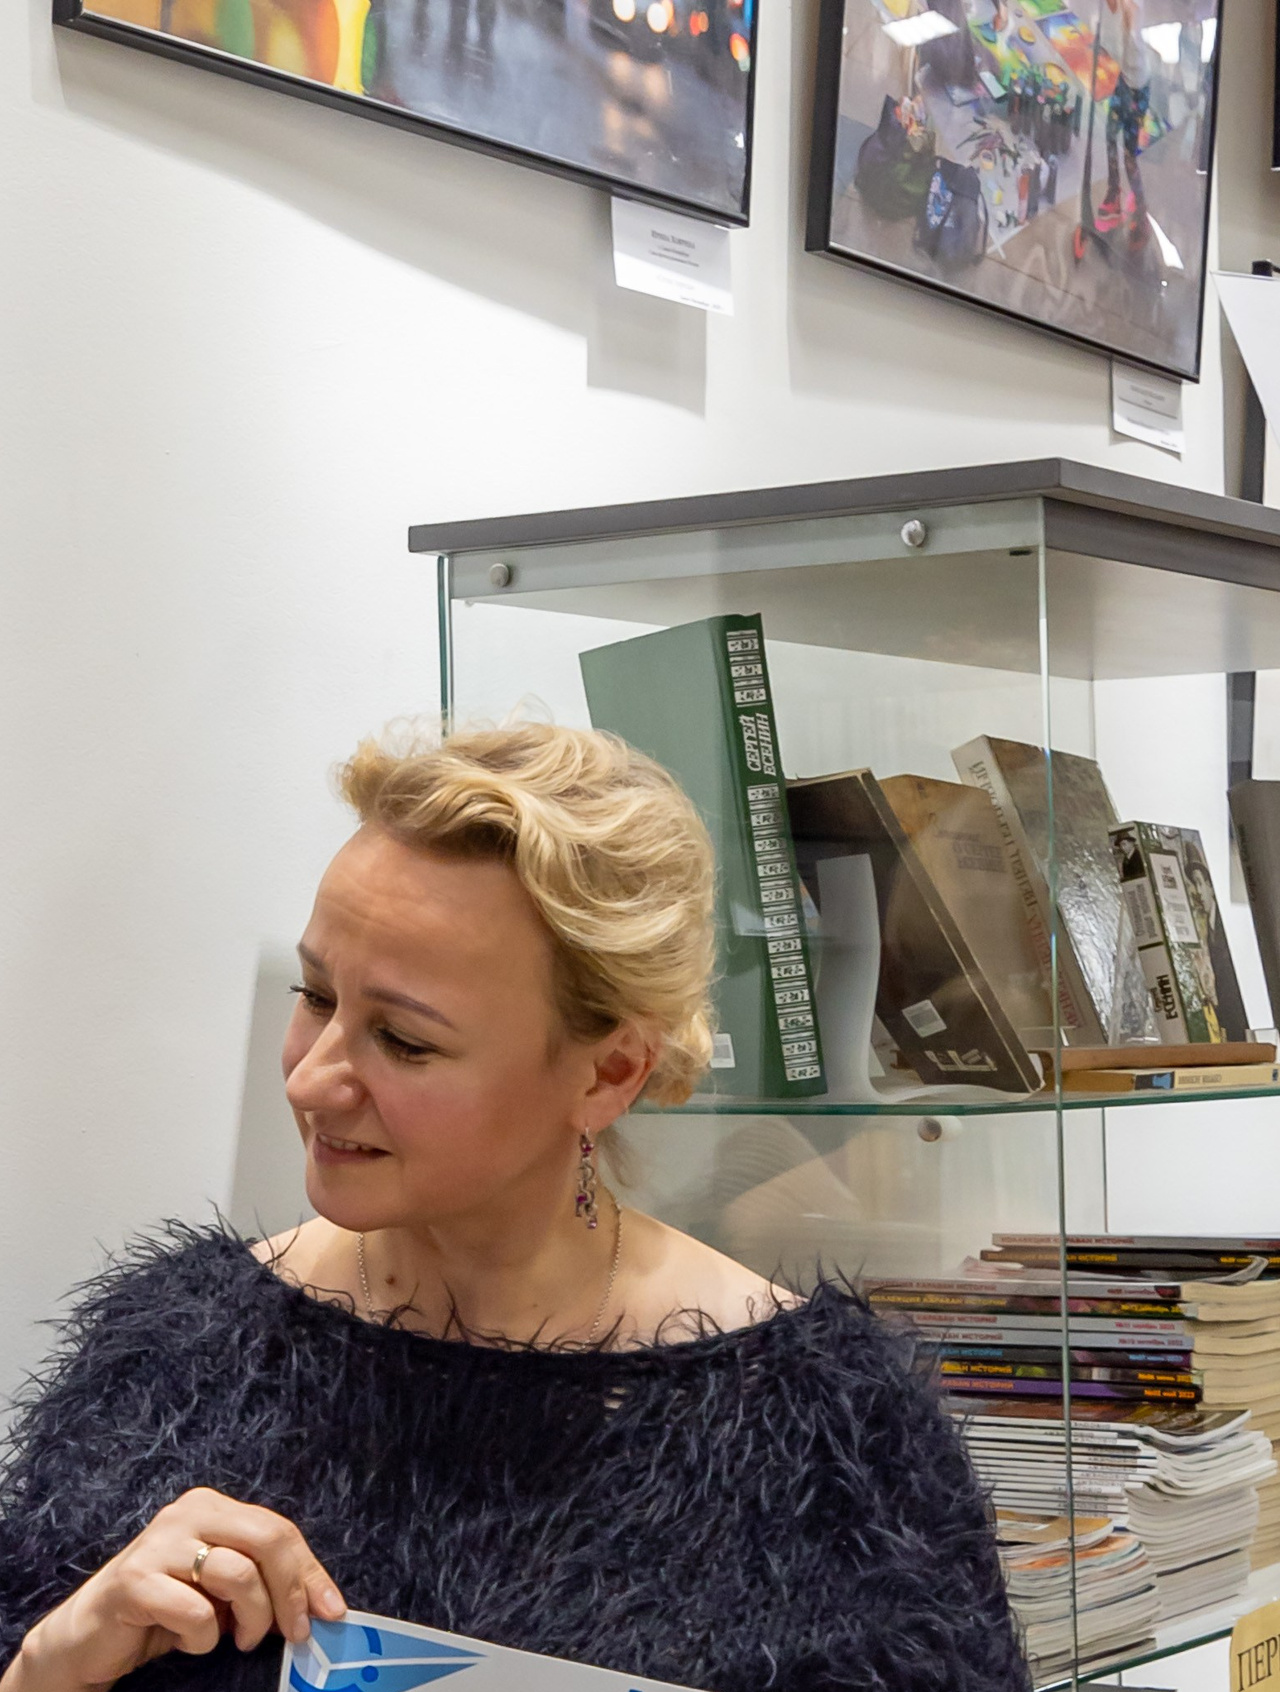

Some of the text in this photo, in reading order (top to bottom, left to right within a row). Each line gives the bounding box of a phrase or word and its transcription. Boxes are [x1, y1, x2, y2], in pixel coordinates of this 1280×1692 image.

[738, 714, 761, 772] СЕРГЕЙ
[755, 712, 776, 777] ЕСЕНИН
[1237, 1633, 1280, 1684] ПЕР
